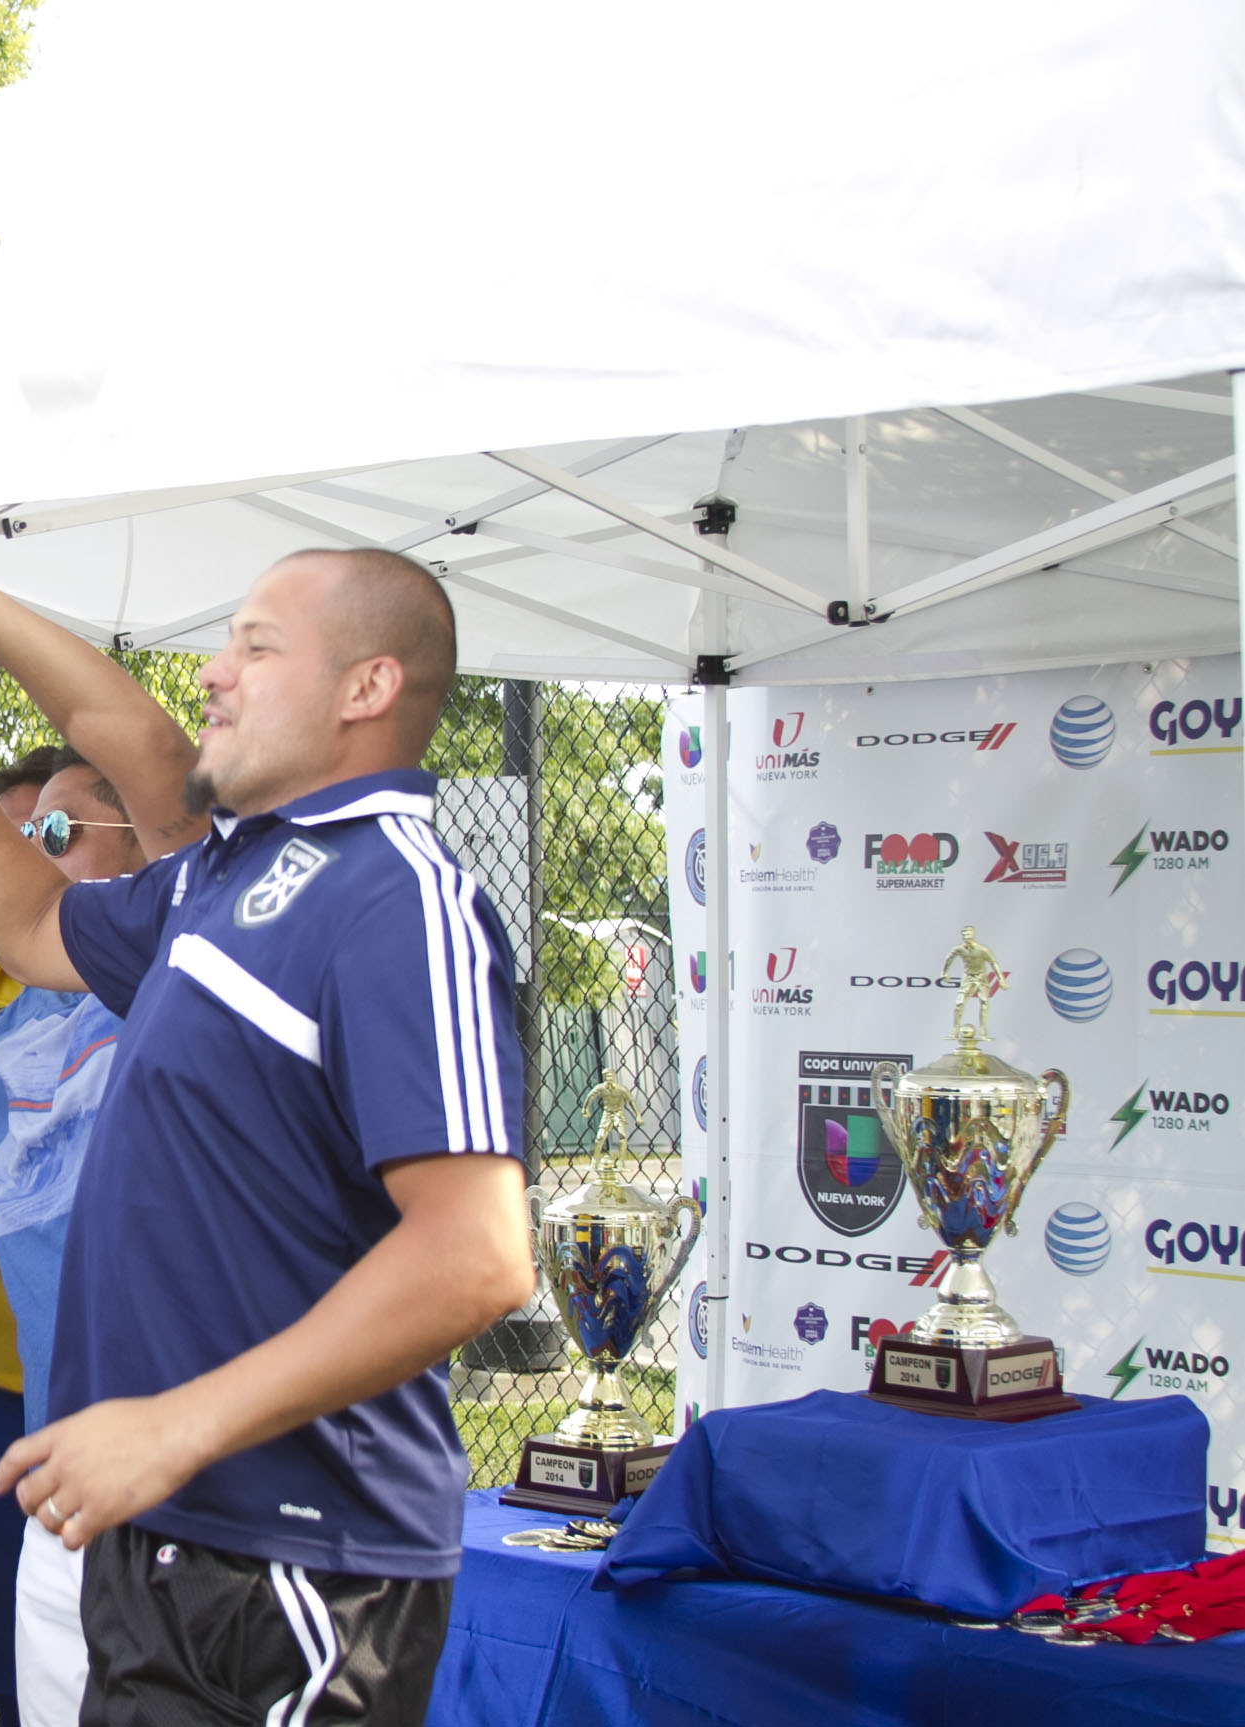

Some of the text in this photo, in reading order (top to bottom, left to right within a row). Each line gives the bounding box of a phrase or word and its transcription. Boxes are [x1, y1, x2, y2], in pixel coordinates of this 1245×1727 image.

[857, 730, 994, 747] DODGE
[756, 769, 818, 781] NUEVA YORK
[1150, 829, 1230, 852] WADO
[876, 860, 945, 875] BAZAAR
[1153, 857, 1210, 870] 1280 AM
[740, 867, 816, 882] EmblemHealth
[876, 878, 945, 889] SUPERMARKET
[850, 975, 962, 989] DODG
[1147, 959, 1245, 1006] GOY
[753, 1006, 812, 1017] NUEVA YORK
[804, 1058, 839, 1072] copa
[1149, 1090, 1230, 1116] WADO
[1152, 1117, 1210, 1132] 1280 AM
[817, 1191, 886, 1207] NUEVA YORK
[1145, 1218, 1245, 1266] GOY
[745, 1242, 935, 1275] DODGE
[731, 1336, 804, 1361] EmblemHealth
[889, 1354, 932, 1370] CAMPEON
[1145, 1346, 1230, 1378] WADO
[900, 1371, 921, 1384] 2014
[989, 1366, 1044, 1386] DODGE
[1149, 1374, 1209, 1392] 1280 AM
[535, 1456, 575, 1471] CAMPEON
[545, 1471, 564, 1483] 2014
[627, 1466, 661, 1482] DOD
